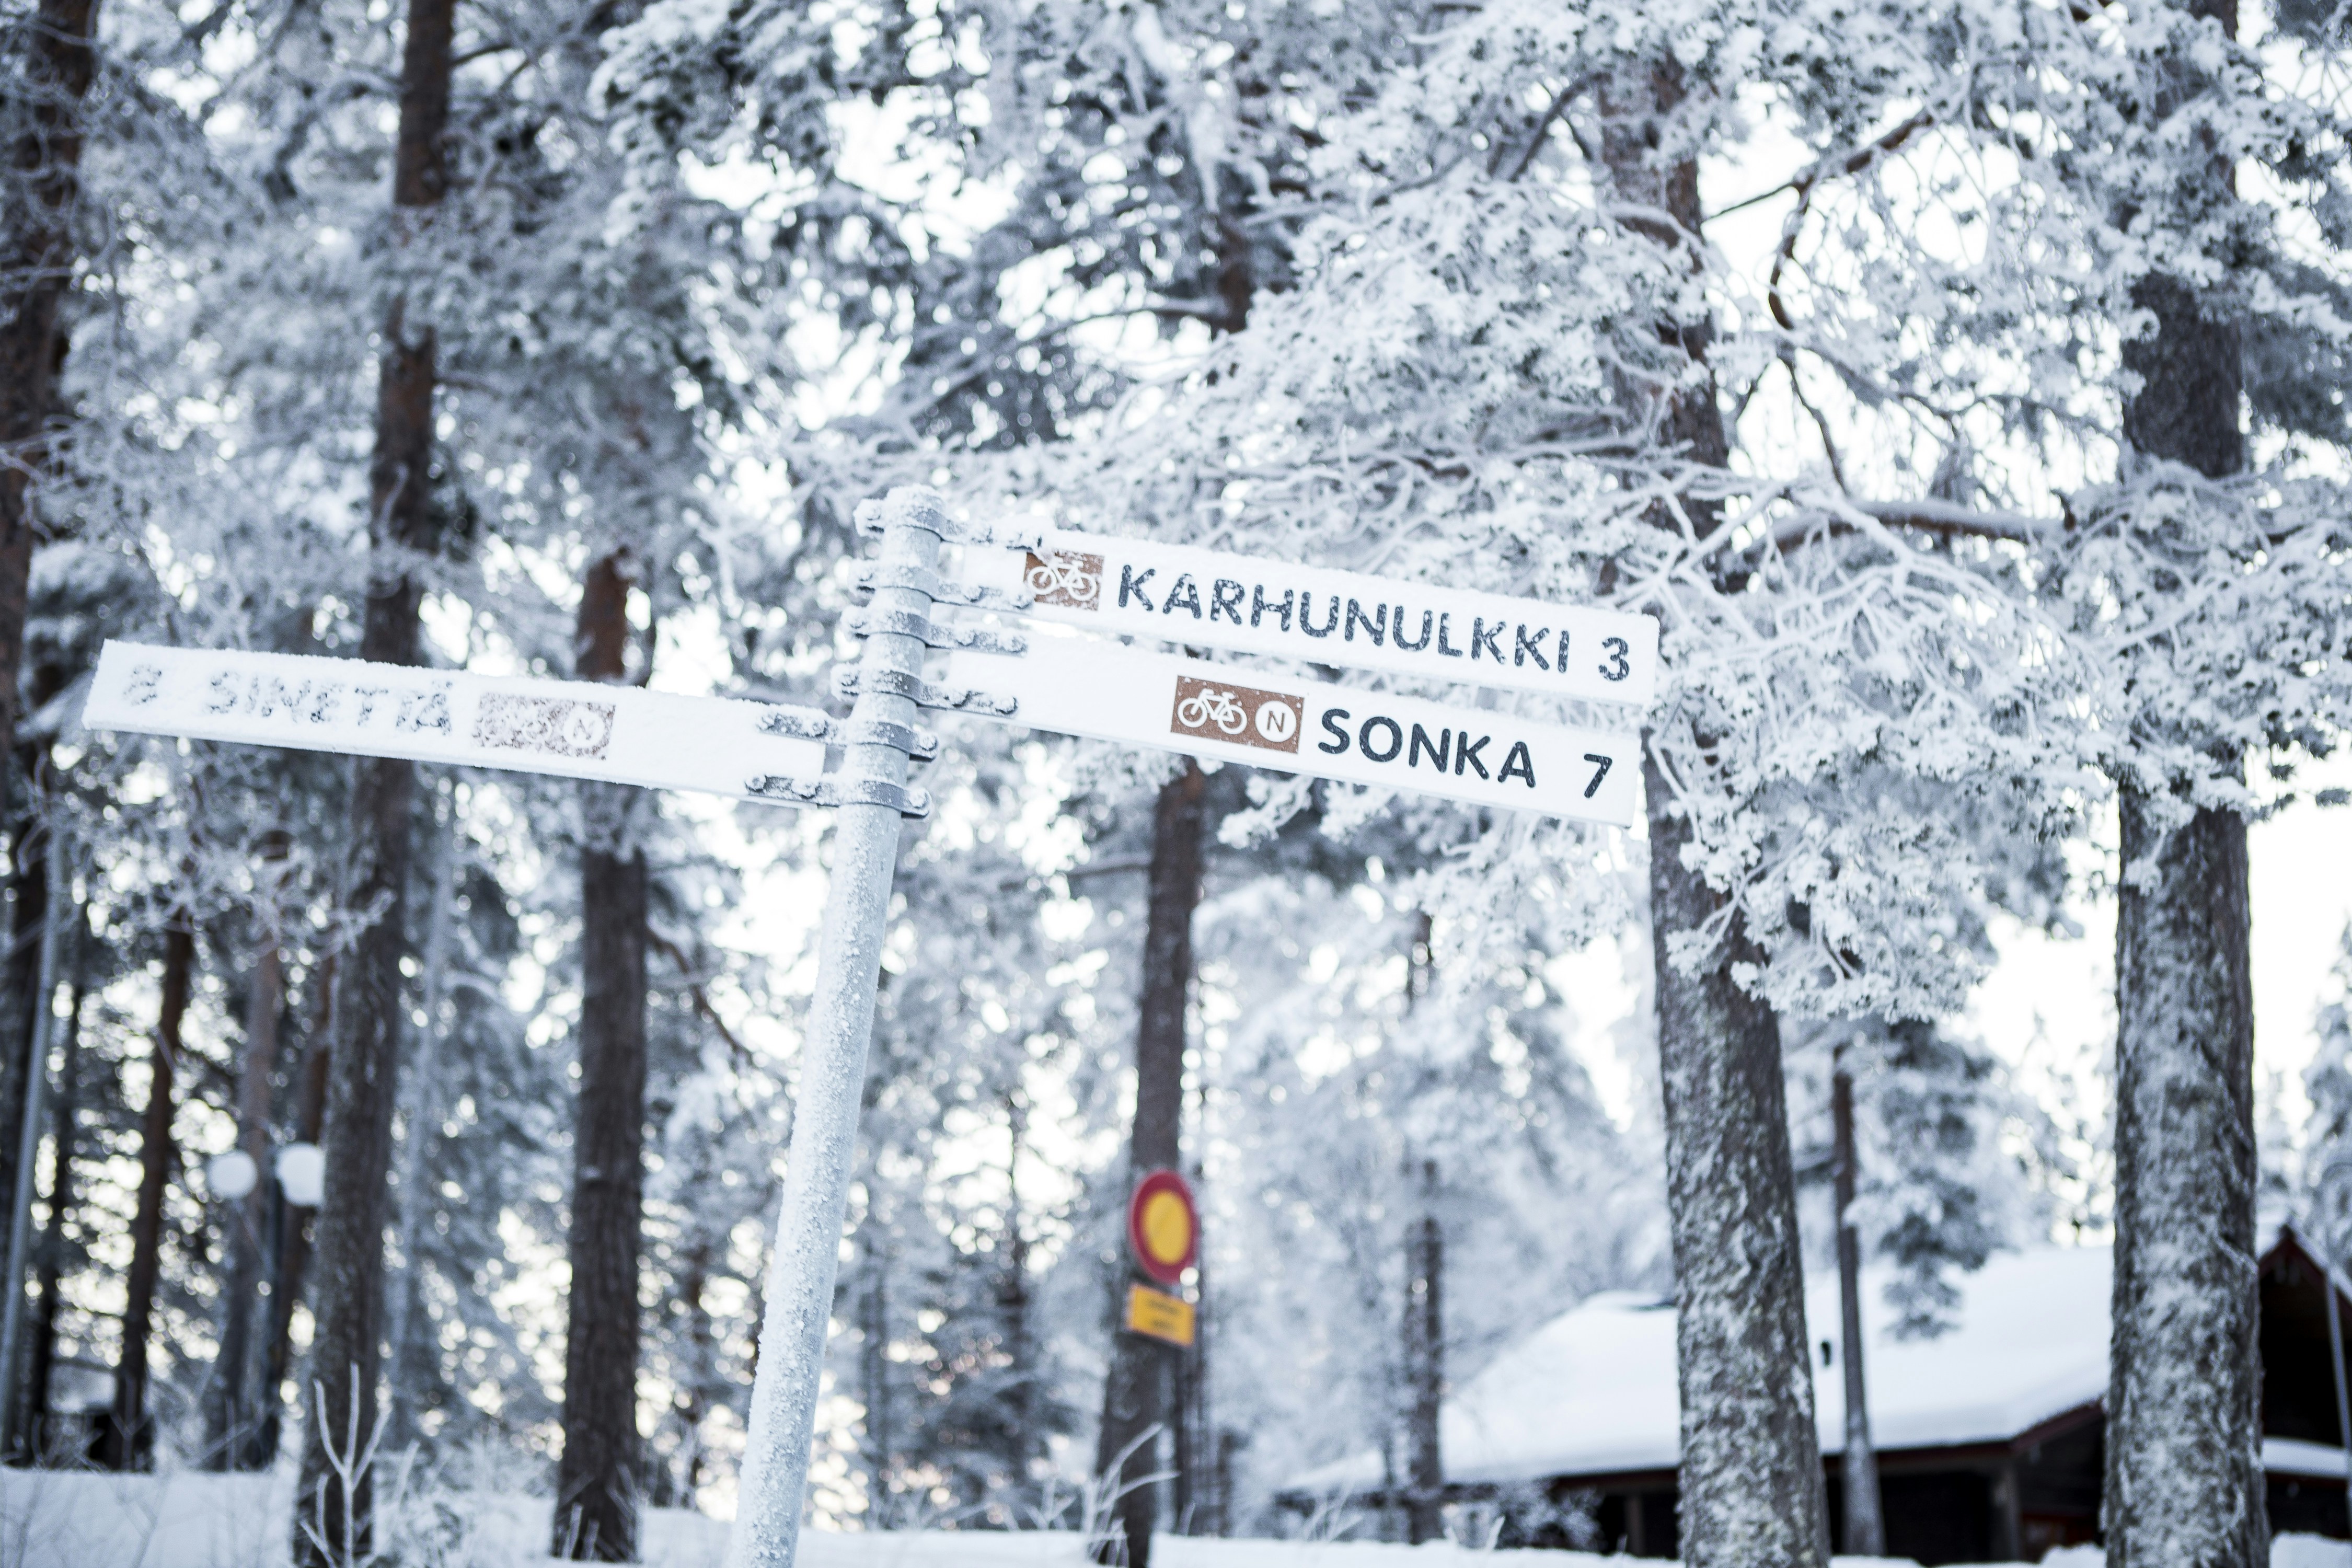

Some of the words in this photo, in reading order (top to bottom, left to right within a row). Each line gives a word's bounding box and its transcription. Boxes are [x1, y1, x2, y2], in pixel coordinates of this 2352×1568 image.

[1117, 563, 1570, 674] KARHUNULKKI
[1597, 636, 1631, 682] 3
[1266, 710, 1285, 733] N
[1317, 707, 1537, 789] SONKA
[1583, 753, 1613, 800] 7
